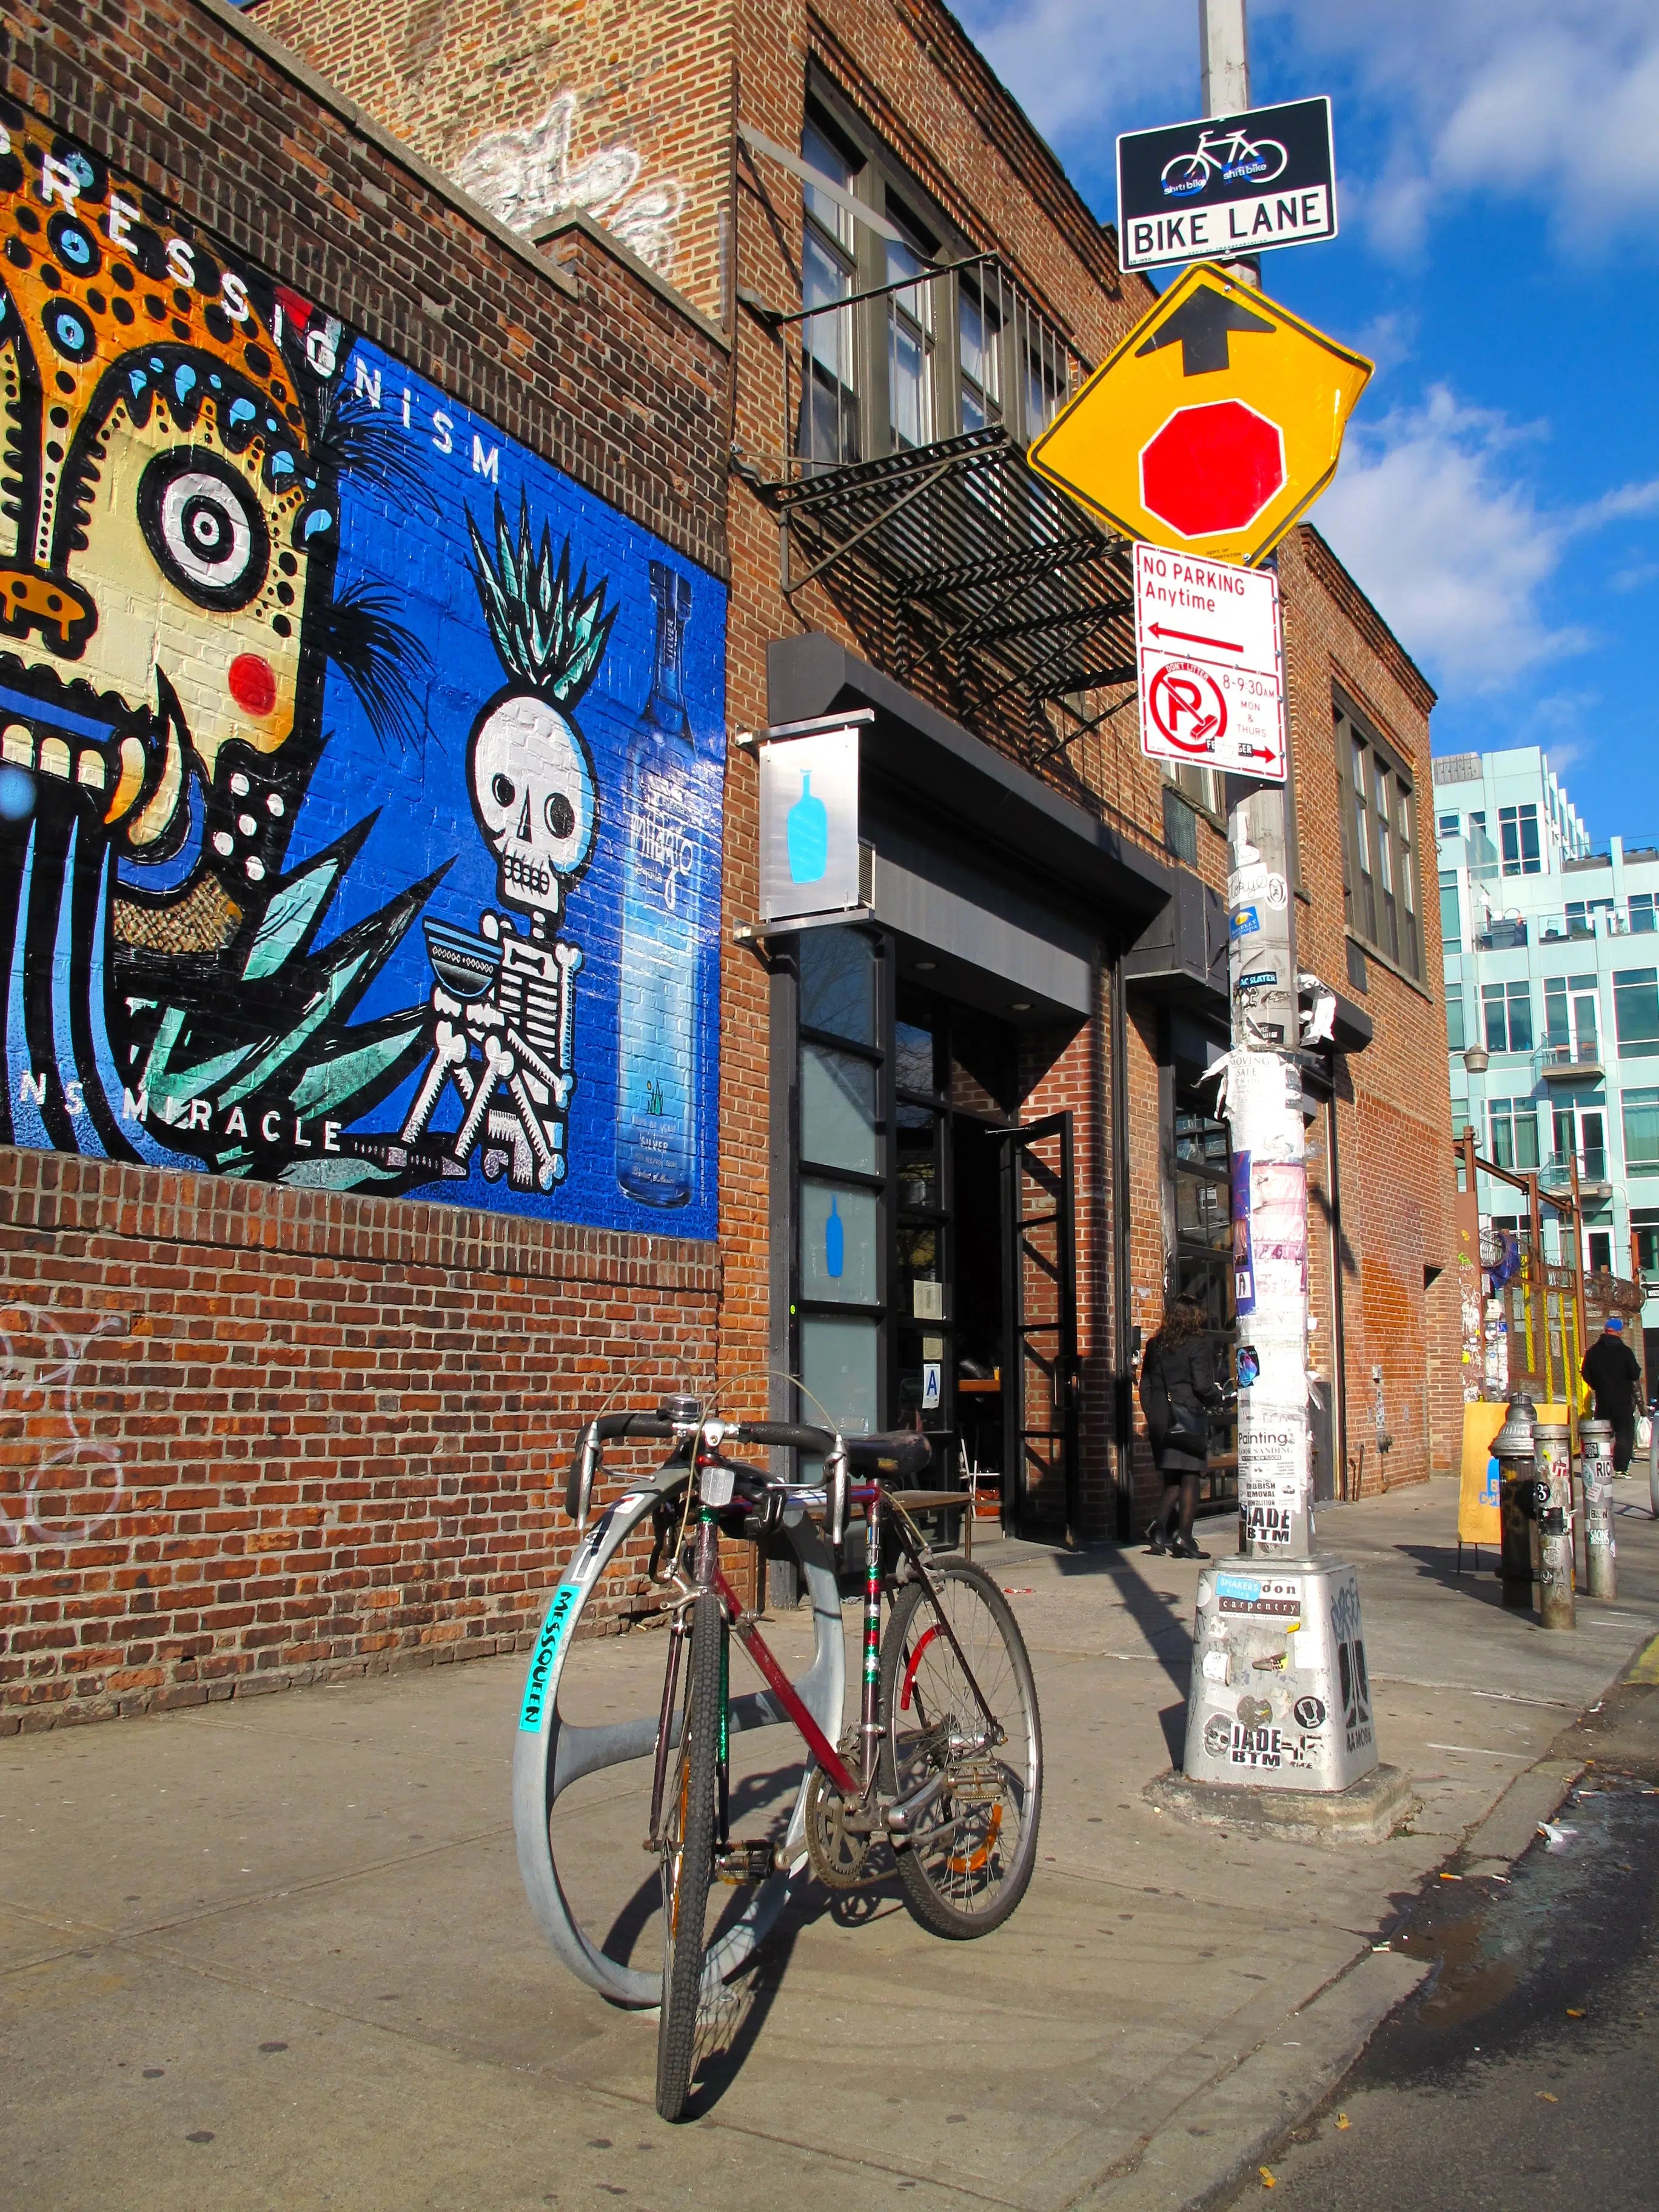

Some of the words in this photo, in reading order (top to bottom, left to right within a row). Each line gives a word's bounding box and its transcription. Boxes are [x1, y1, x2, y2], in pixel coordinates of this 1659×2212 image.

[1246, 163, 1267, 175] bike
[1134, 213, 1208, 255] BIKE
[1229, 192, 1321, 239] LANE
[1144, 555, 1167, 577] NO
[1173, 563, 1245, 596] PARKING
[1145, 581, 1216, 612] Anytime
[1165, 662, 1184, 673] DON'T
[1187, 663, 1209, 681] LITTER
[1241, 699, 1261, 711] MON
[1236, 723, 1267, 738] THURS
[1249, 974, 1276, 985] SLATER
[1229, 1057, 1270, 1065] MOVING
[1237, 1068, 1256, 1076] SALE
[122, 1087, 342, 1151] MIRACLE
[640, 1136, 668, 1153] SILVER
[927, 1369, 937, 1396] A
[1238, 1431, 1287, 1446] Painting
[1247, 1507, 1290, 1529] JADE
[1247, 1527, 1290, 1543] BTM
[1219, 1578, 1258, 1592] SHAKERS
[1262, 1584, 1296, 1594] oon
[1222, 1599, 1296, 1614] carpentry
[525, 1591, 572, 1723] MESSQUEEN
[1233, 1726, 1281, 1753] JADE
[1232, 1750, 1281, 1767] BTM
